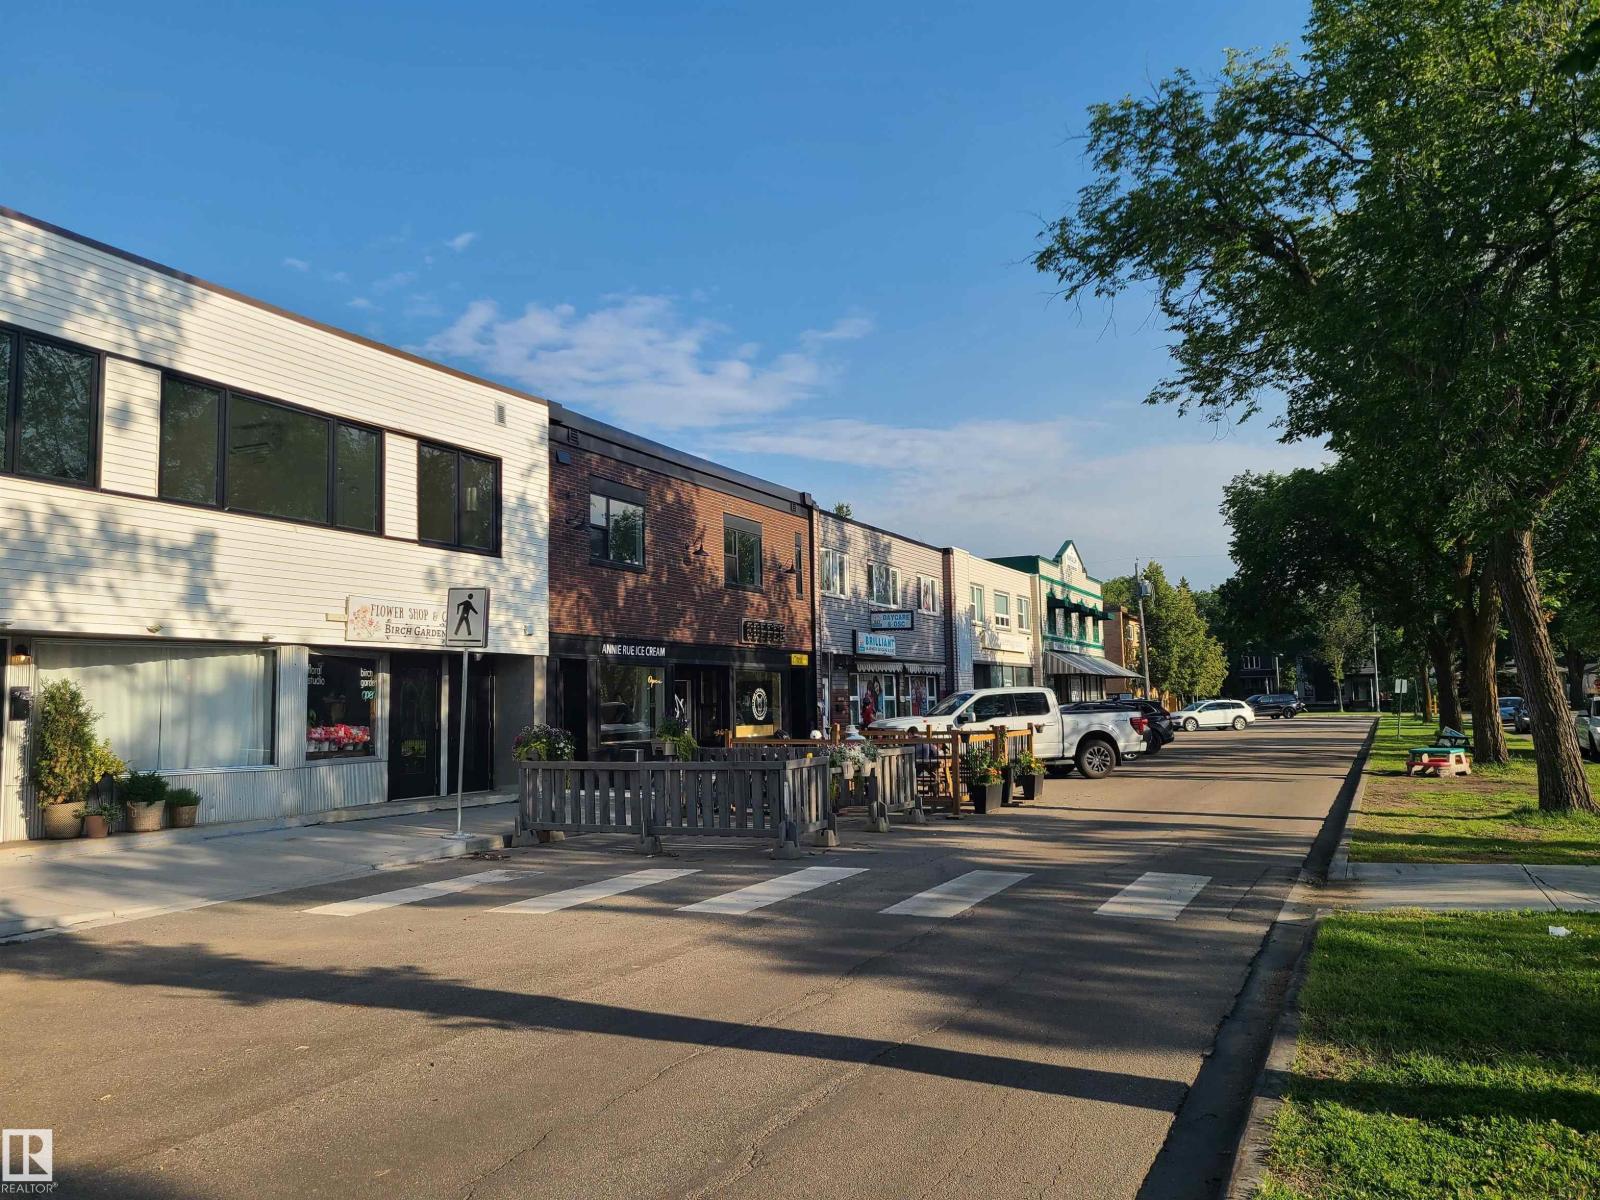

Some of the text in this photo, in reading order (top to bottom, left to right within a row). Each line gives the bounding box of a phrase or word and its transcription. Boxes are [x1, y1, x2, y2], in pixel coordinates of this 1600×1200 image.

[371, 604, 404, 619] FLOWER
[408, 607, 429, 621] SHOP
[432, 611, 439, 622] &
[385, 624, 413, 636] BIRCH
[865, 636, 895, 647] BRILLIANT
[601, 643, 666, 657] ANNIE RUE ICE CREAM
[360, 667, 374, 677] birch
